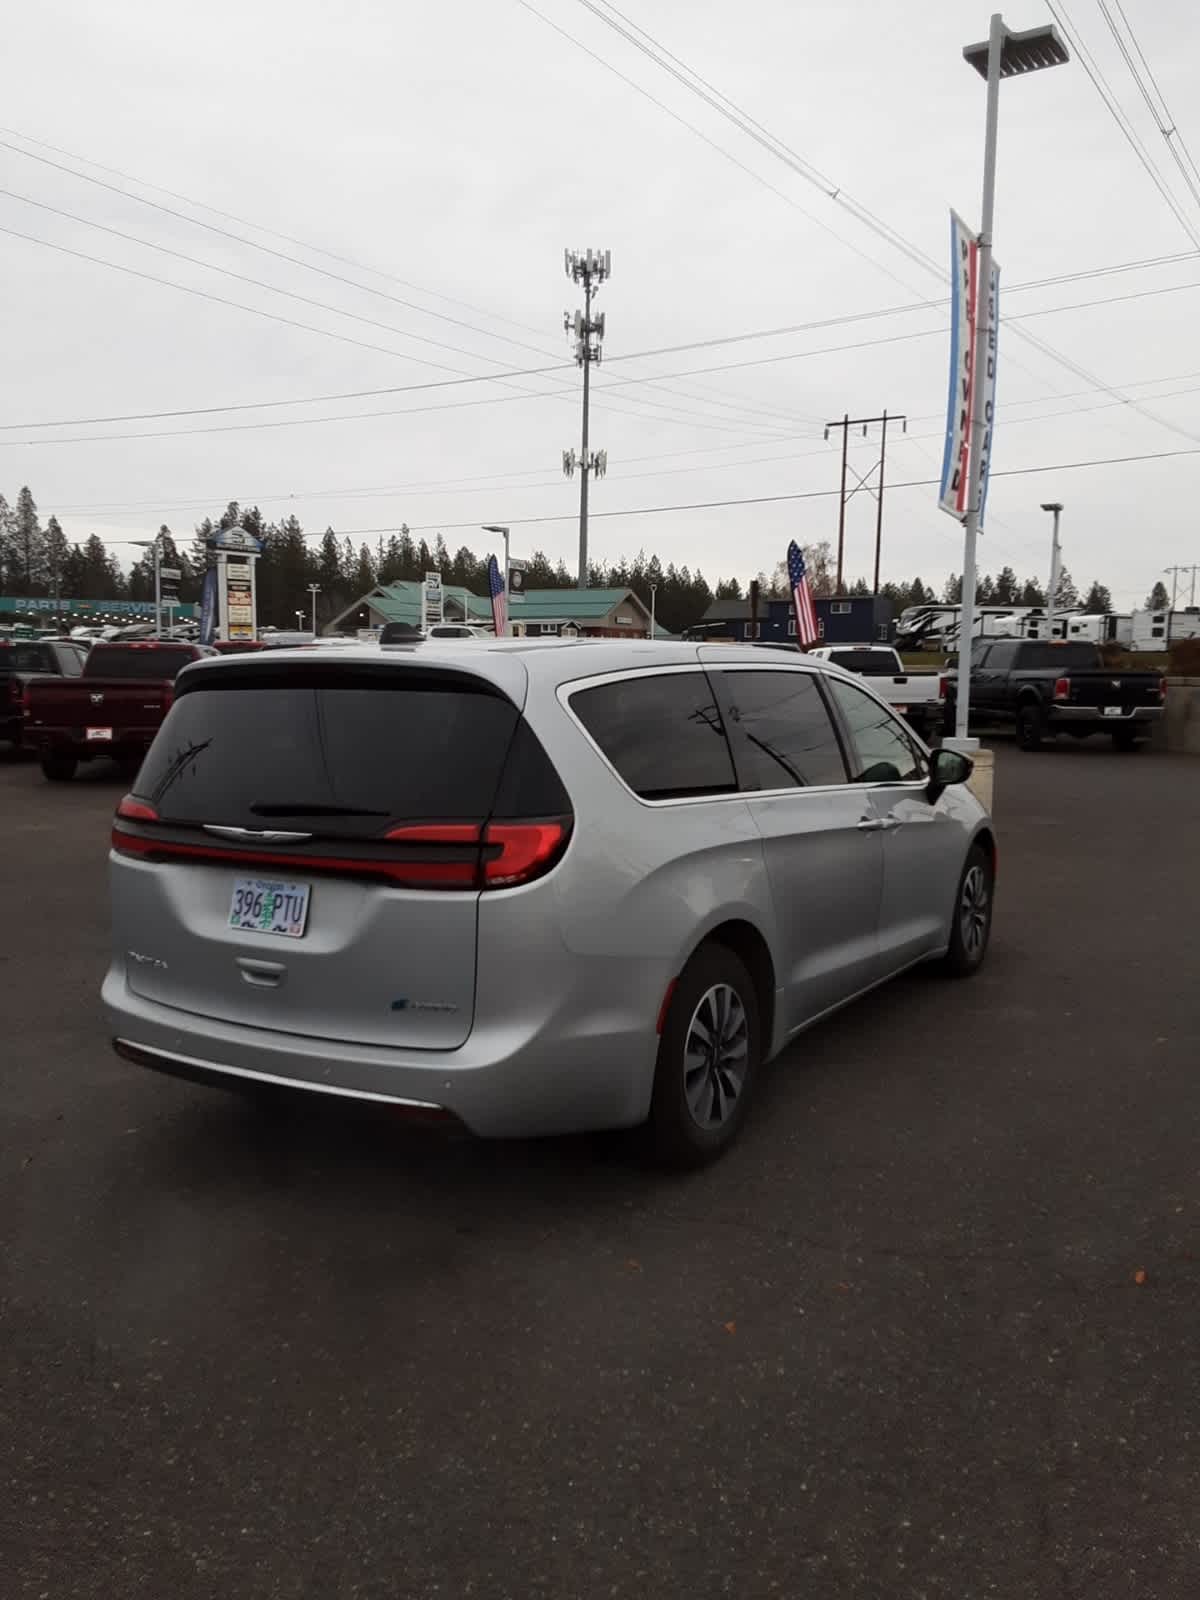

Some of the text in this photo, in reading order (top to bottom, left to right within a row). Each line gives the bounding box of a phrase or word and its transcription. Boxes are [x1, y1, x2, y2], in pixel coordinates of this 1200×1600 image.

[15, 599, 71, 610] PARTS
[99, 601, 168, 614] SERVICE
[233, 889, 304, 923] 396 PTU
